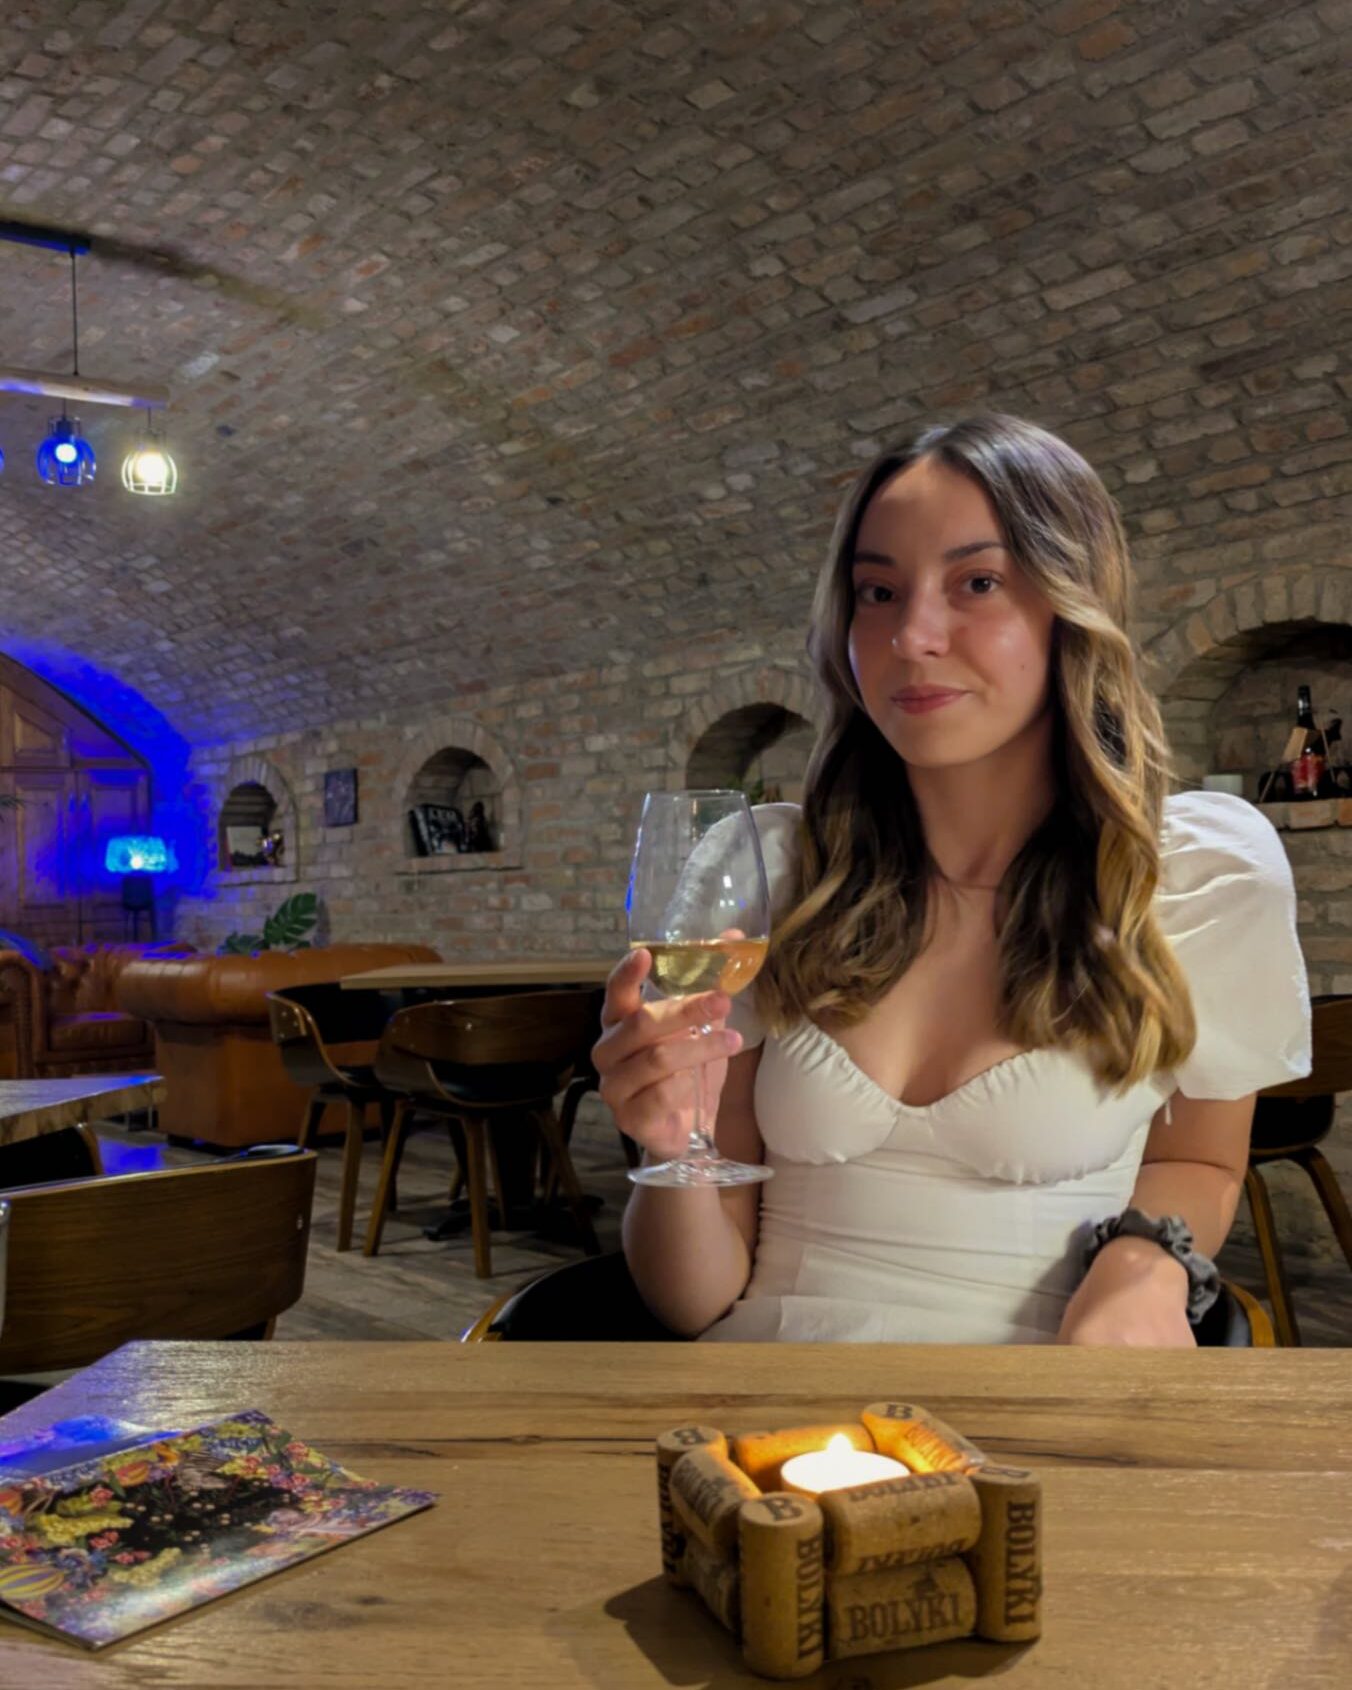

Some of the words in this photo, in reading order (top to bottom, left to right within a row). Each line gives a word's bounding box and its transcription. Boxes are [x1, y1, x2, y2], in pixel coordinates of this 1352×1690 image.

[886, 1404, 912, 1419] B
[763, 1496, 802, 1521] B
[1005, 1501, 1036, 1627] BOLYKI
[797, 1538, 822, 1660] BOLYKI
[847, 1593, 962, 1641] BOLYKI
